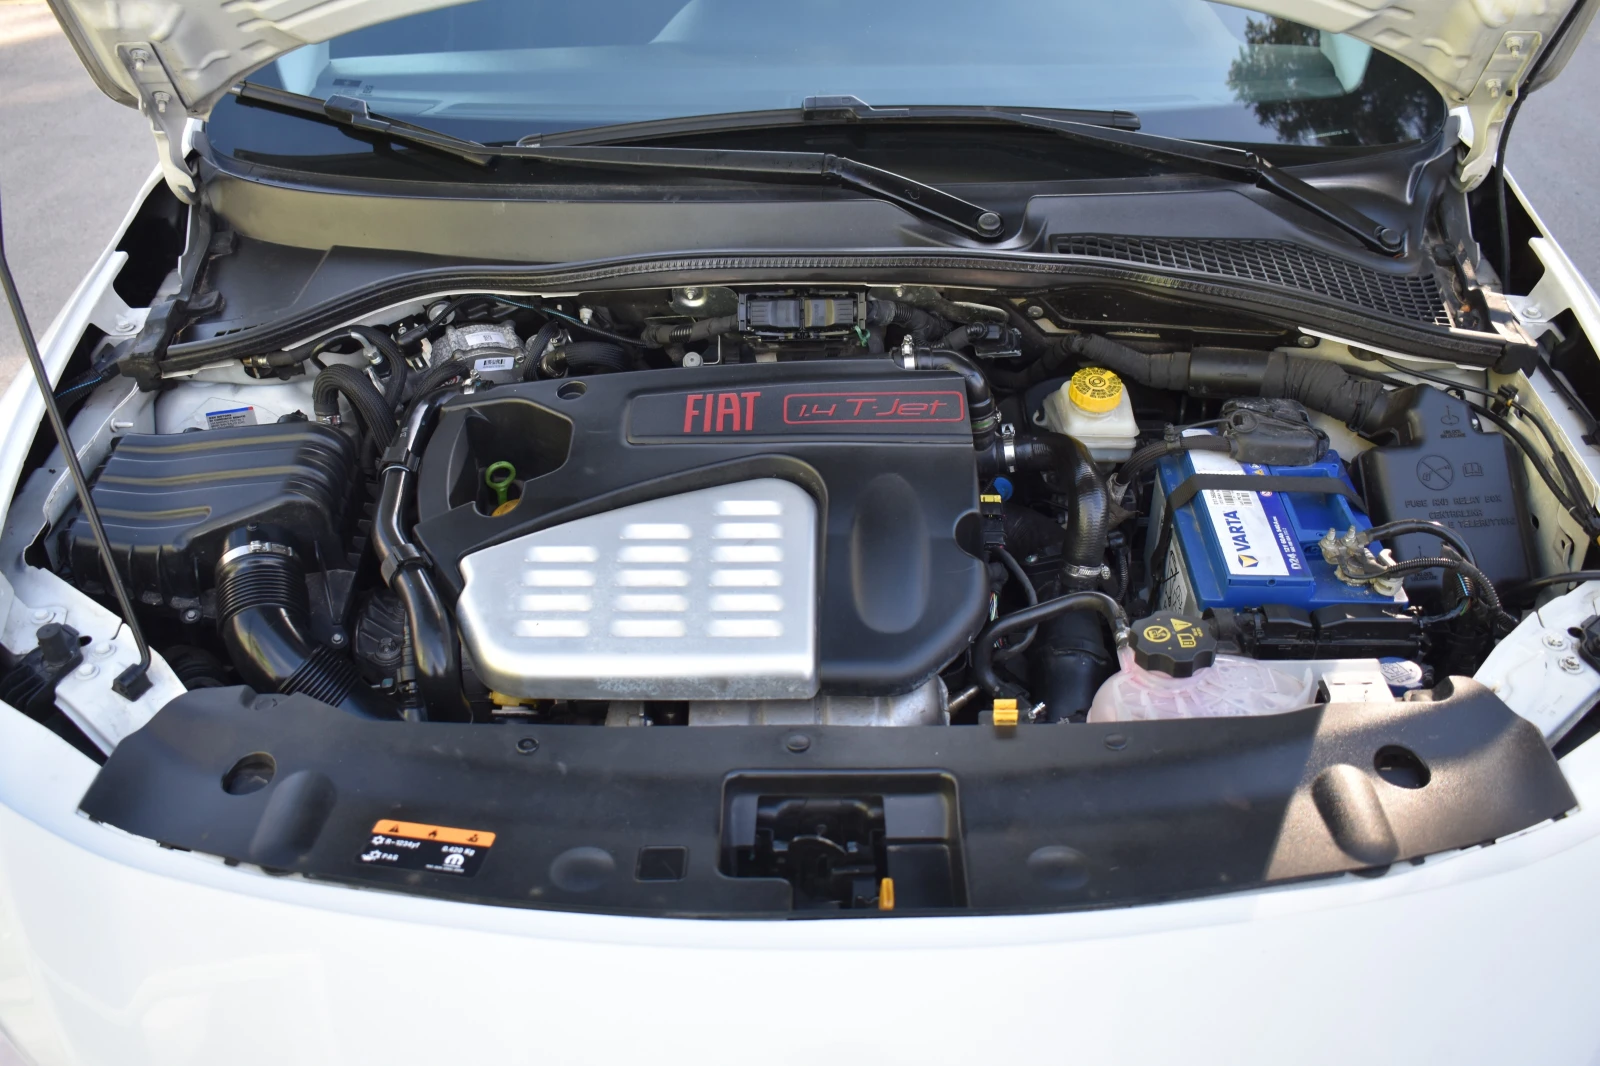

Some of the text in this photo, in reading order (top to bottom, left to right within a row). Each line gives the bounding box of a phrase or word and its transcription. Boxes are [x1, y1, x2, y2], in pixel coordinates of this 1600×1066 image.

[683, 392, 761, 432] FIAT
[799, 398, 947, 417] 1.4 T-Jet
[1405, 494, 1502, 508] FUSE AND RELAY BOX
[1223, 510, 1251, 552] VARTA
[1286, 553, 1302, 569] D24
